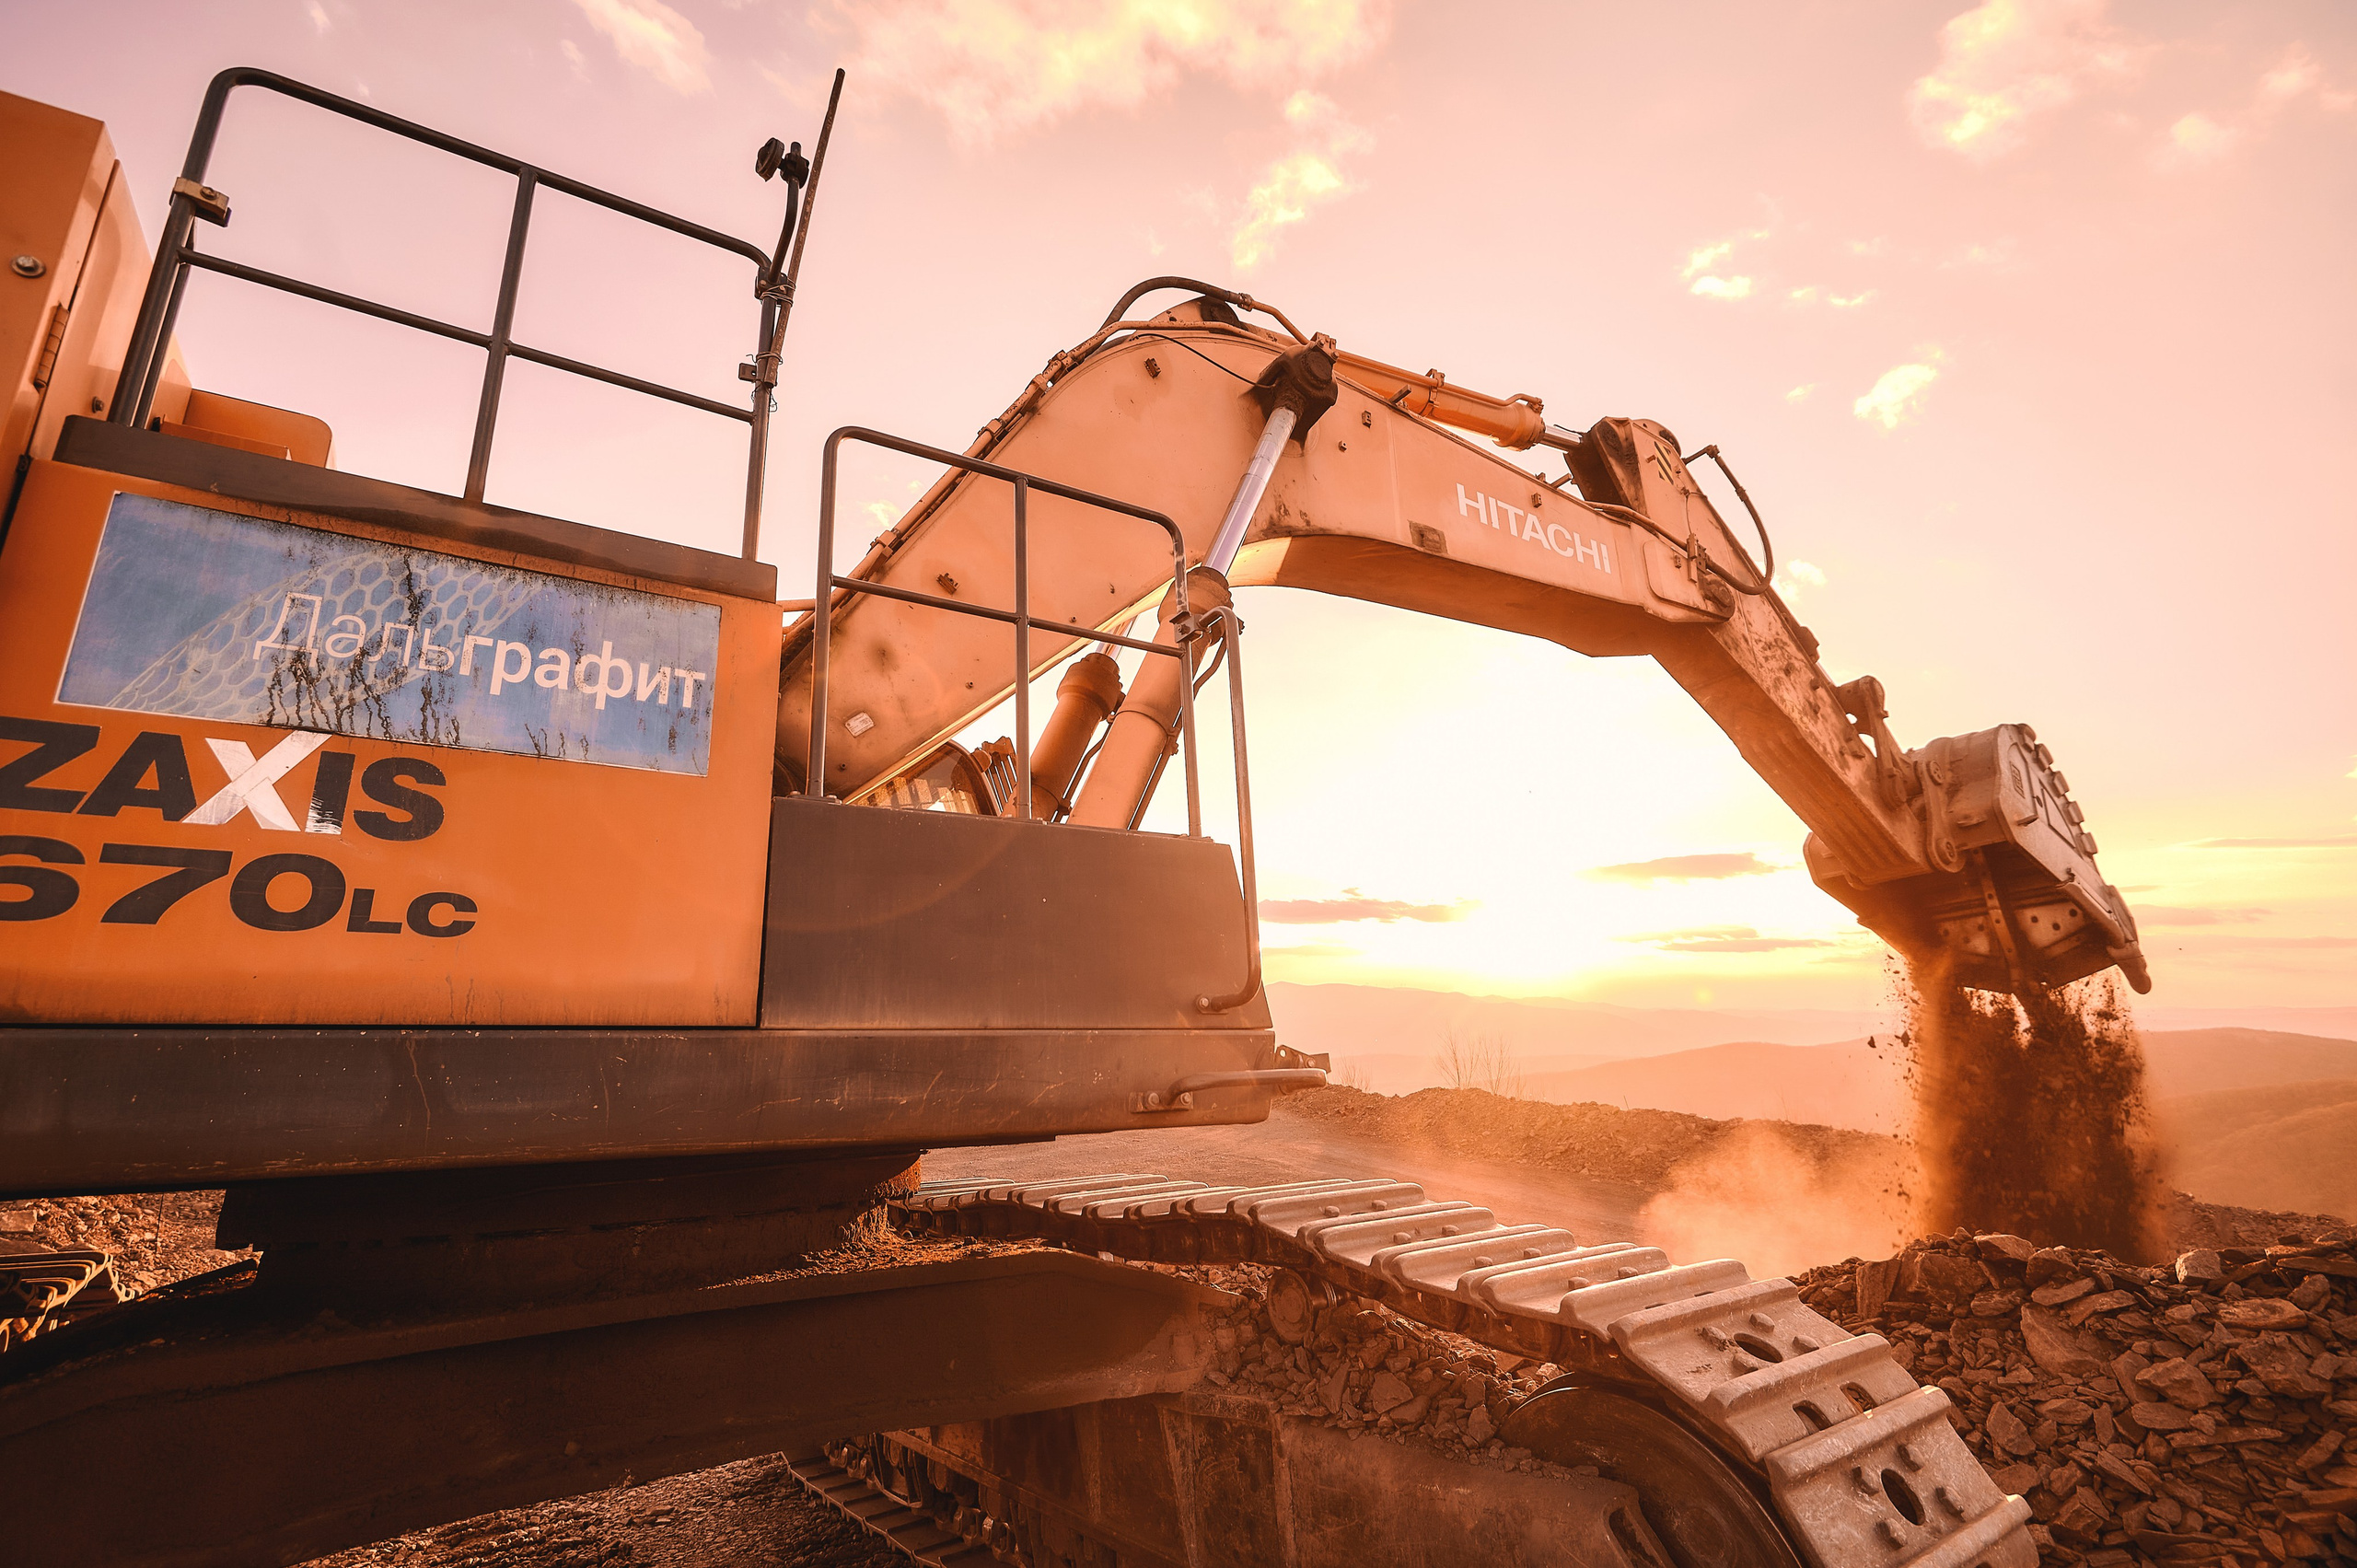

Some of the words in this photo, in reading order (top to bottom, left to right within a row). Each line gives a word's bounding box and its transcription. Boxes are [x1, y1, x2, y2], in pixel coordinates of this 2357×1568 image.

[1457, 483, 1611, 574] HITACHI
[253, 592, 705, 710] Дальграфит
[0, 716, 447, 842] ZAXIS
